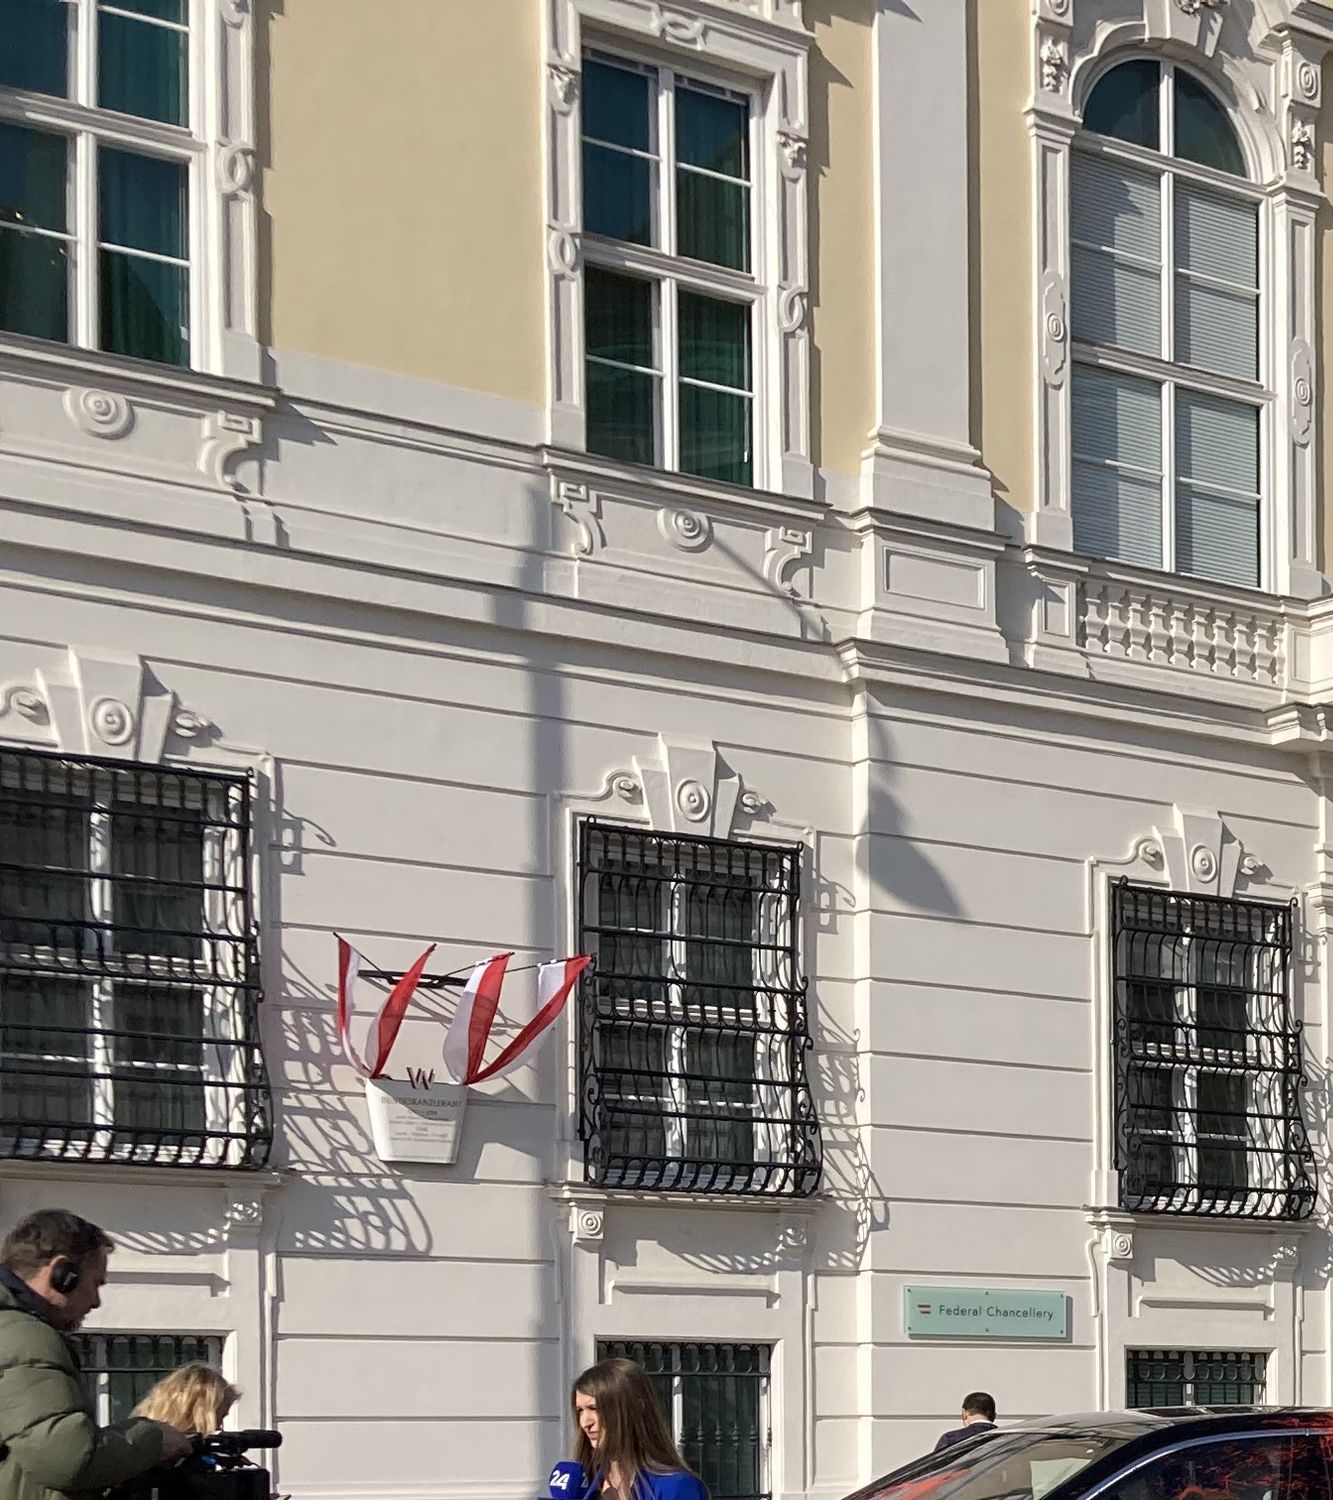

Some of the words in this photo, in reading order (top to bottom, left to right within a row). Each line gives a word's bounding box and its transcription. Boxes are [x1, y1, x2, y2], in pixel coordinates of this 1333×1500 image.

[938, 1304, 983, 1317] Federal
[986, 1305, 1055, 1322] Chancellery
[549, 1469, 571, 1491] 24
